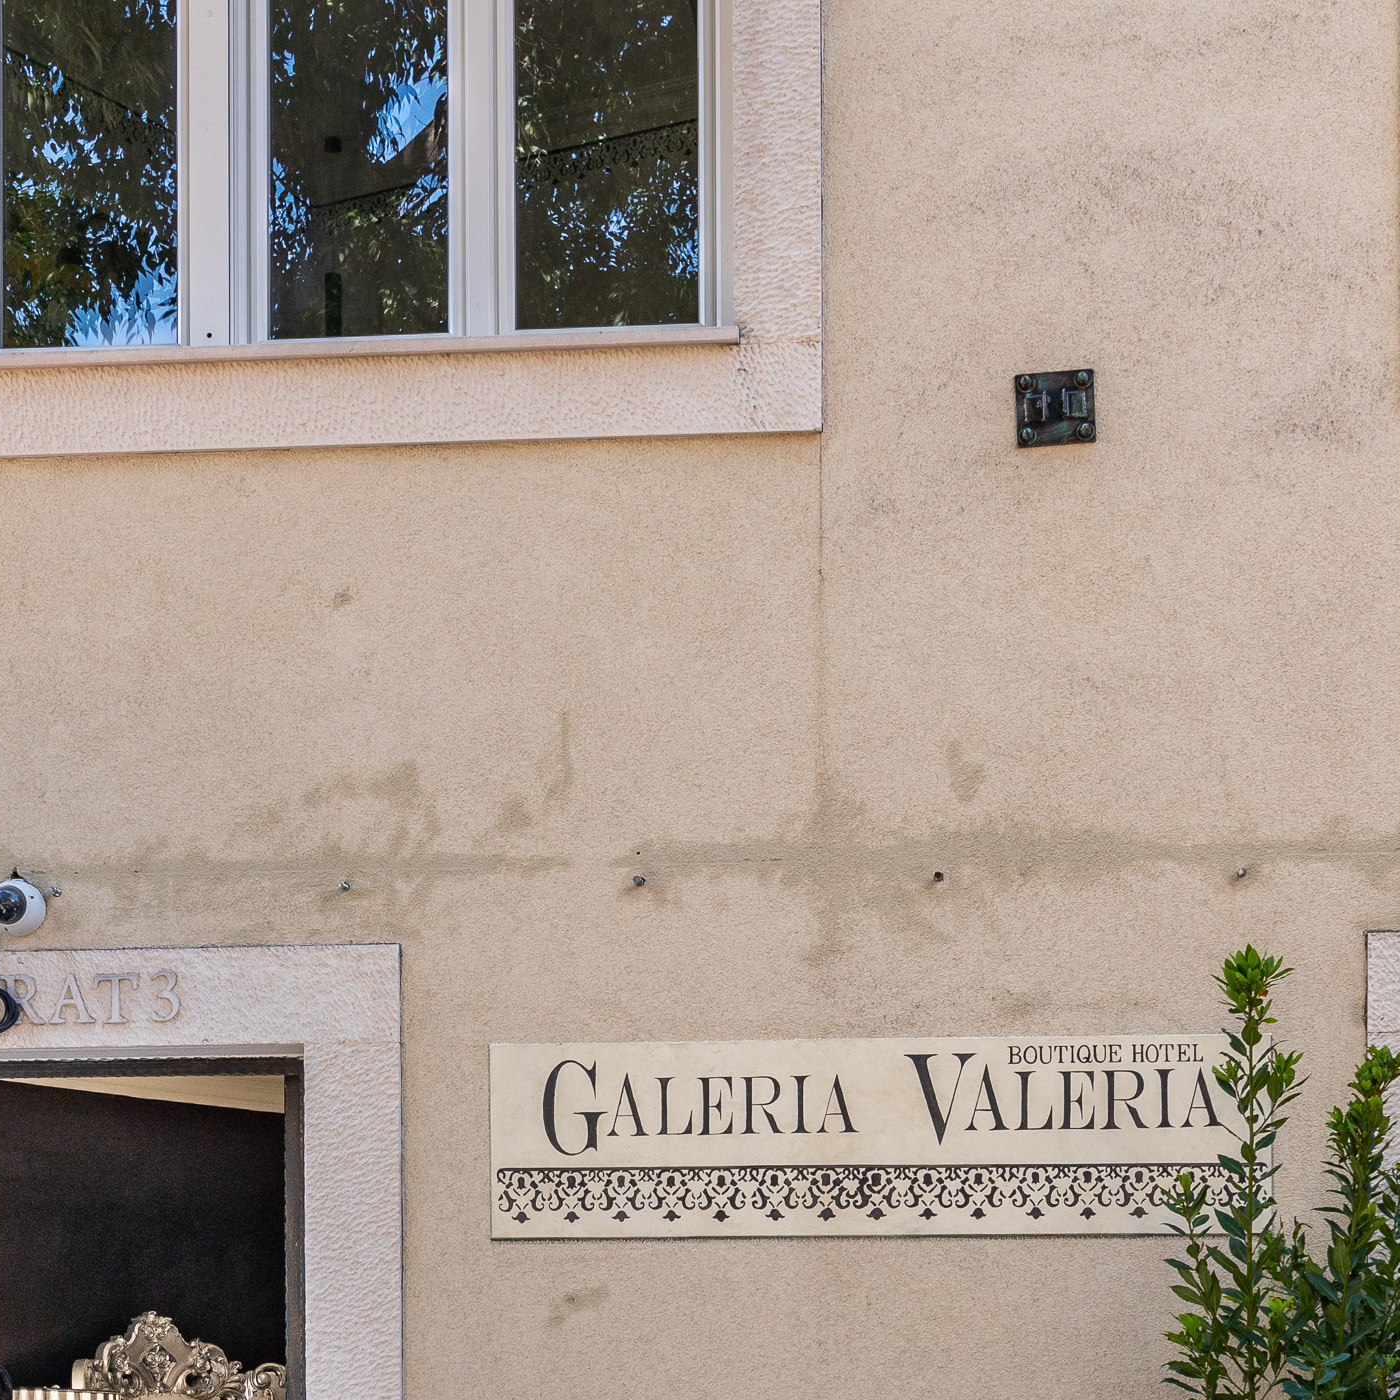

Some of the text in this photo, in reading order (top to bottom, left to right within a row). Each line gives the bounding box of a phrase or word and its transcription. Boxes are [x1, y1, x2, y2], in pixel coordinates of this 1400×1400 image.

[150, 968, 181, 1022] 3
[1007, 1043, 1204, 1065] BOUTIQUE HOTEL
[542, 1052, 1222, 1157] GALERIA VALERIA
